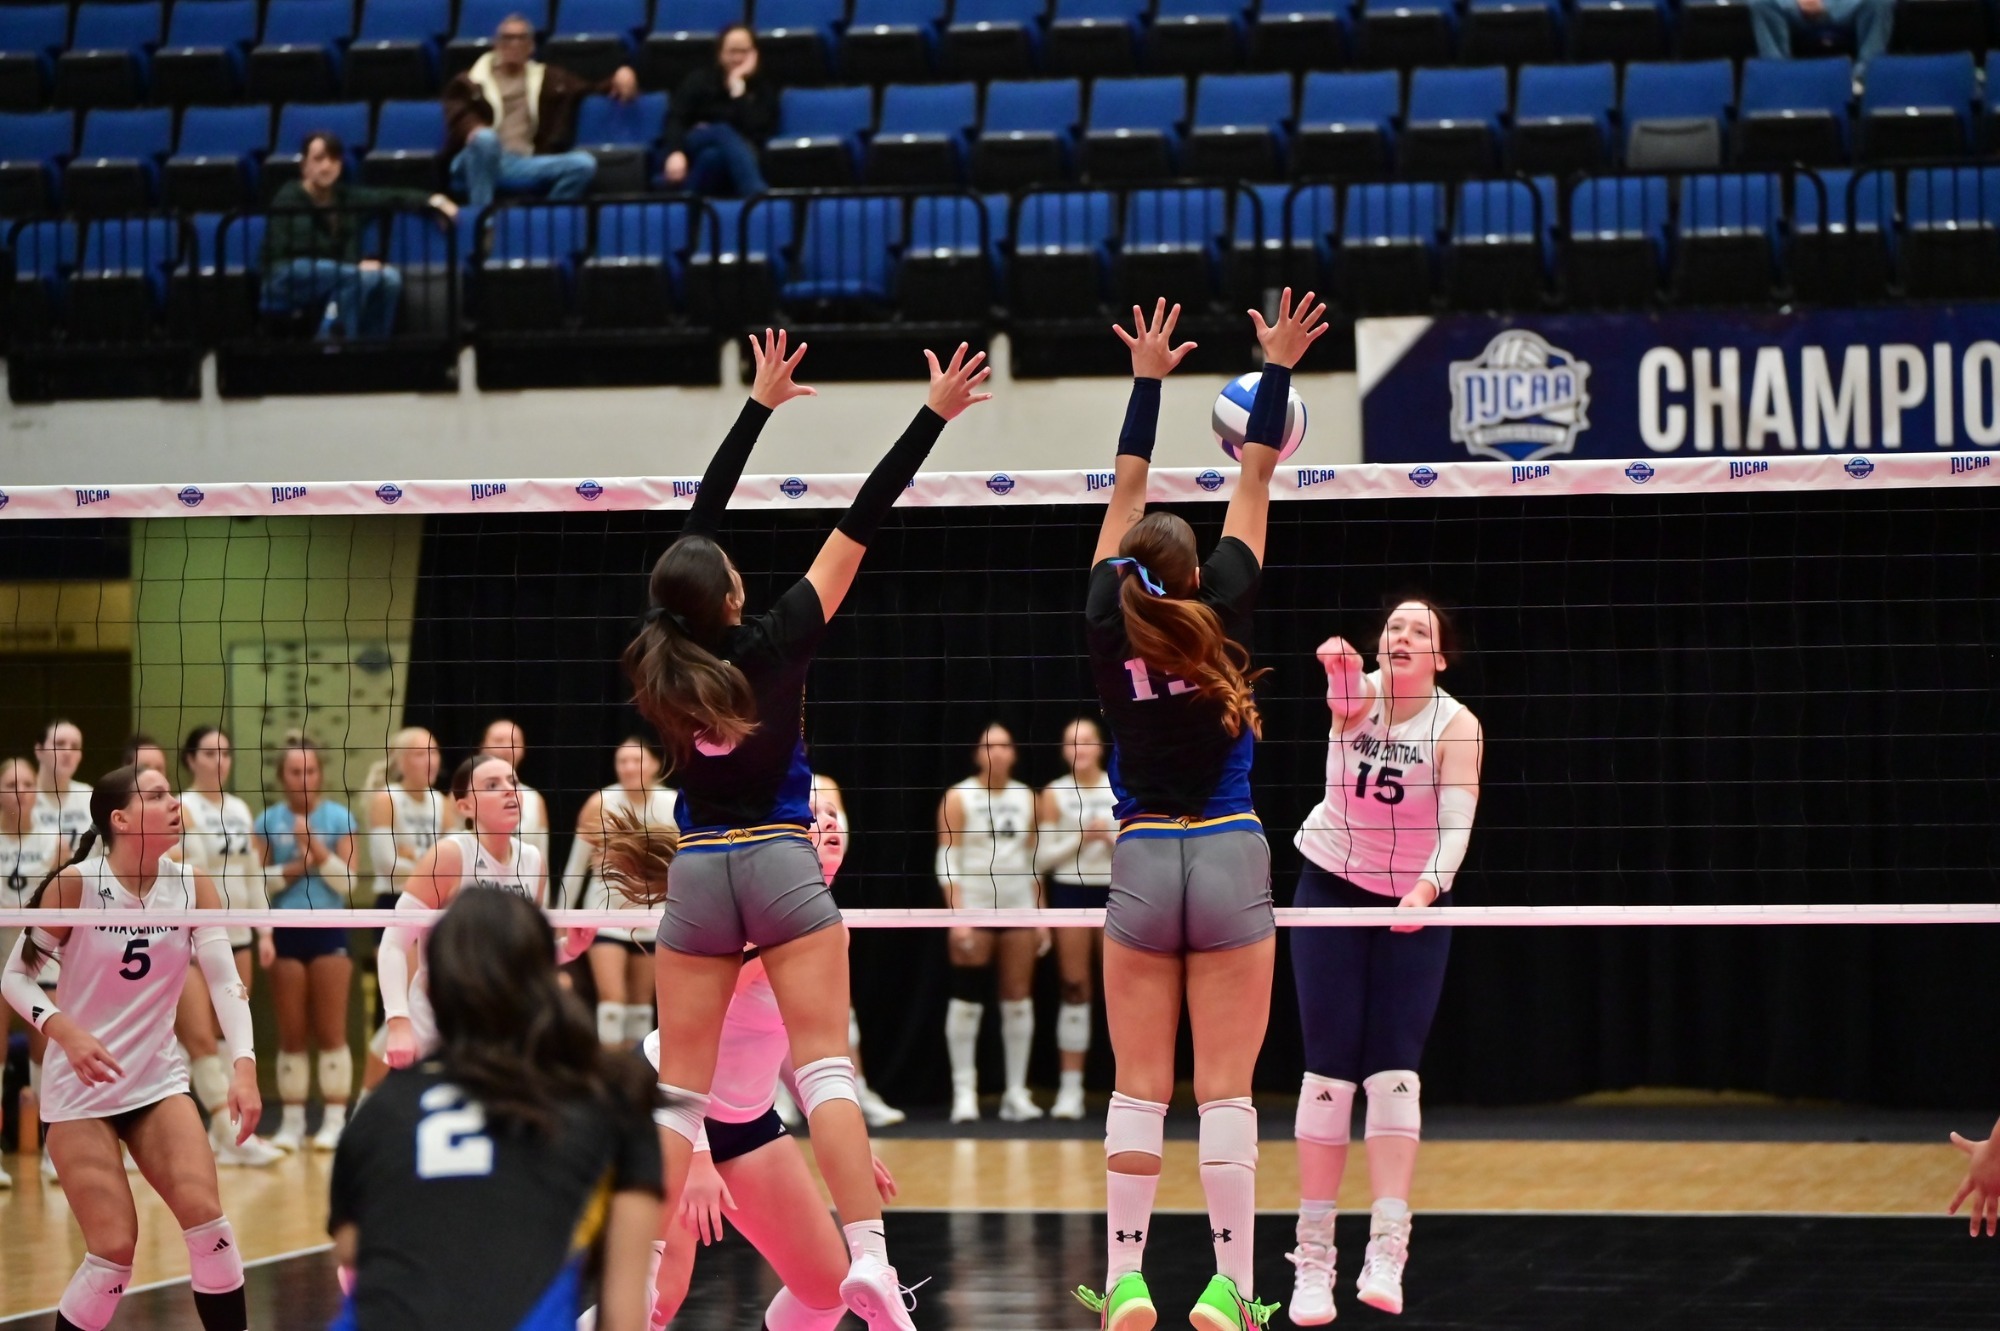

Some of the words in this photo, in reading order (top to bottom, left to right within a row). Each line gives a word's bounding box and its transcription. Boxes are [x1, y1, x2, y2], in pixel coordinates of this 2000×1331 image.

[1465, 373, 1571, 424] NJCAA
[1637, 340, 2000, 453] CHAMPIO
[1511, 465, 1550, 484] NJCAA
[1729, 461, 1769, 479] NJCAA
[1951, 456, 1990, 475] NJCAA
[1086, 473, 1116, 491] NJCA
[1297, 469, 1335, 488] NJCAA
[76, 489, 110, 507] NJCAA
[271, 486, 307, 504] NJCAA
[471, 483, 507, 501] NJCAA
[673, 480, 703, 498] NJCA
[1355, 761, 1405, 805] 15
[119, 938, 151, 981] 5
[415, 1083, 493, 1180] 2
